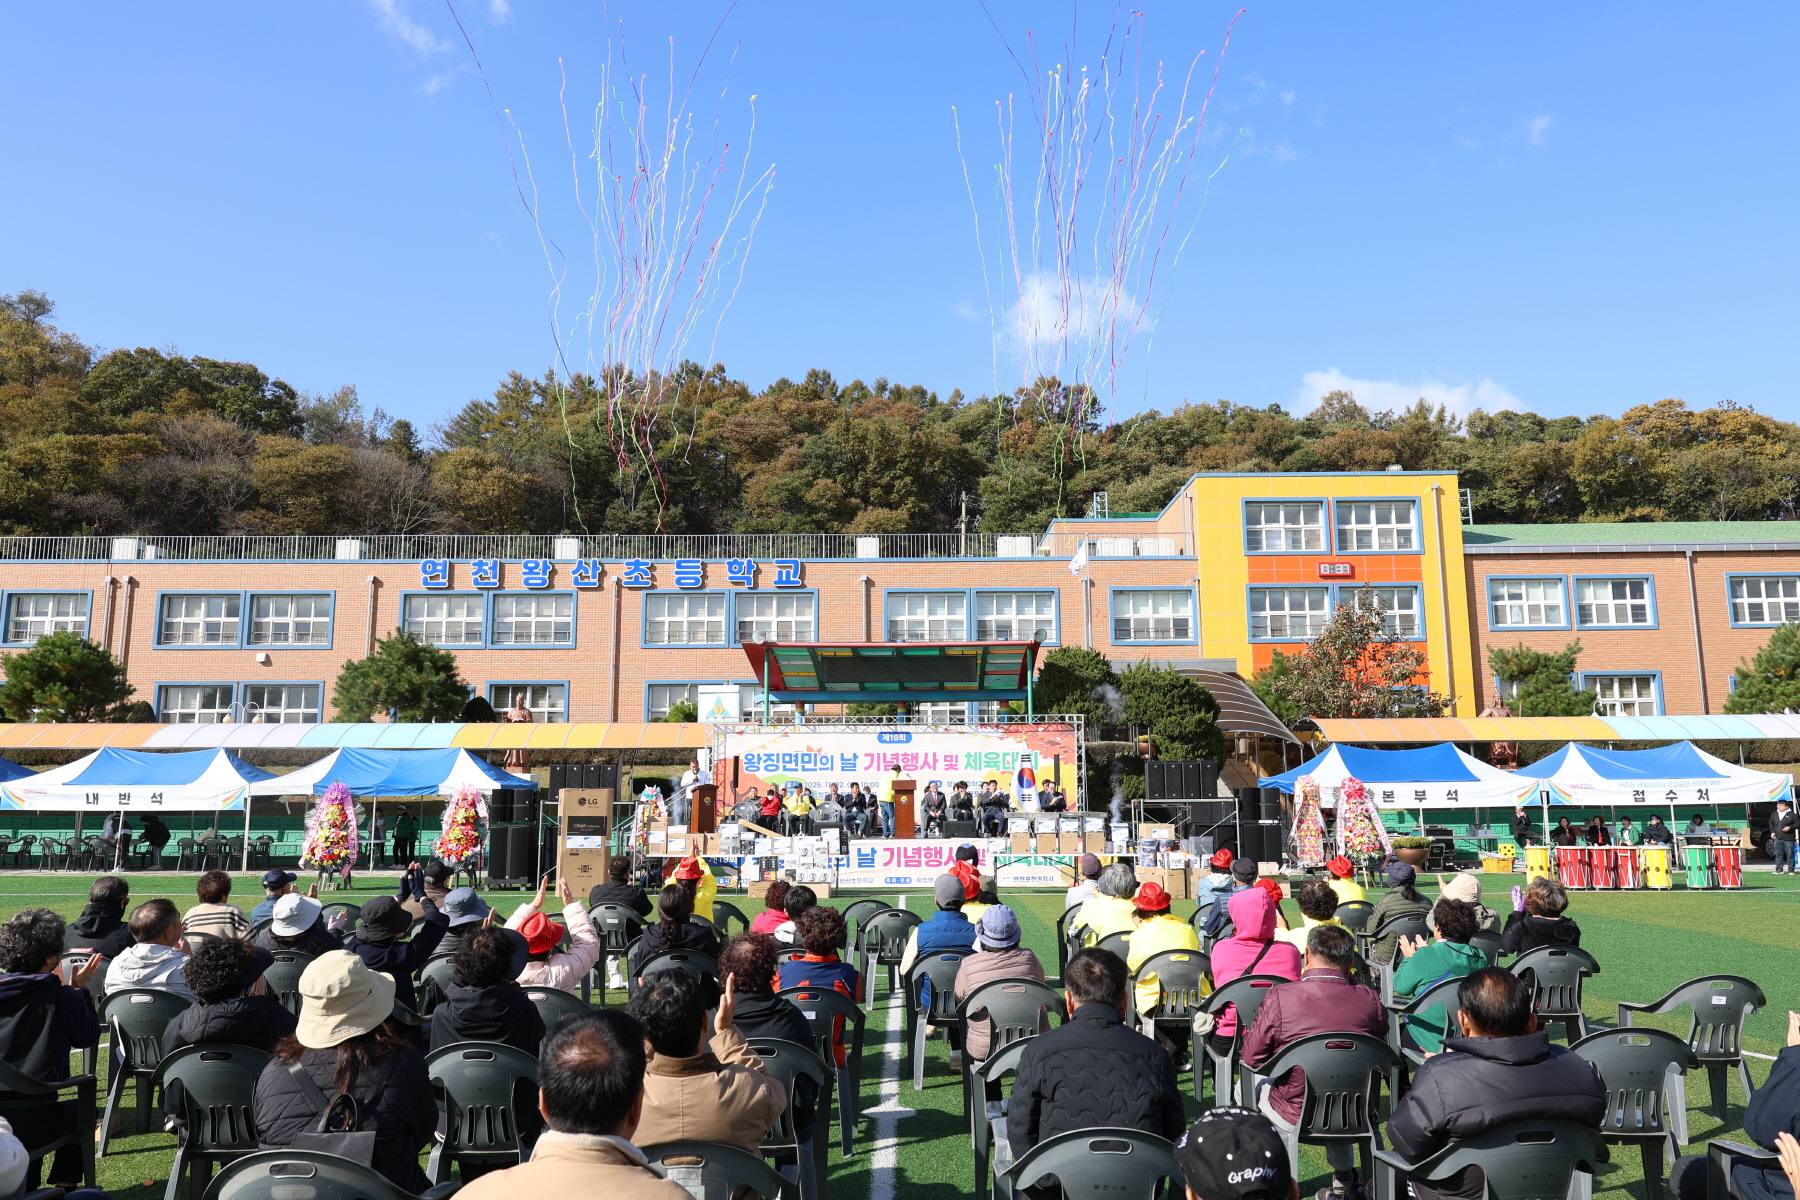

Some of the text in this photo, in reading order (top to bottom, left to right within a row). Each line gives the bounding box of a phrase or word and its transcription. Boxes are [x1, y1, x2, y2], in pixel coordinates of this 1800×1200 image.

[420, 558, 802, 588] 연천왕산초등학교
[882, 733, 906, 741] 제19회
[743, 753, 834, 772] 왕징면민의
[840, 753, 858, 771] 날
[864, 752, 938, 771] 기념행사
[943, 754, 959, 771] 및
[85, 792, 163, 805] 내빈석
[1382, 789, 1459, 802] 본부석
[1632, 789, 1710, 802] 접수처
[857, 847, 877, 868] 날
[1227, 1166, 1276, 1184] Graphy
